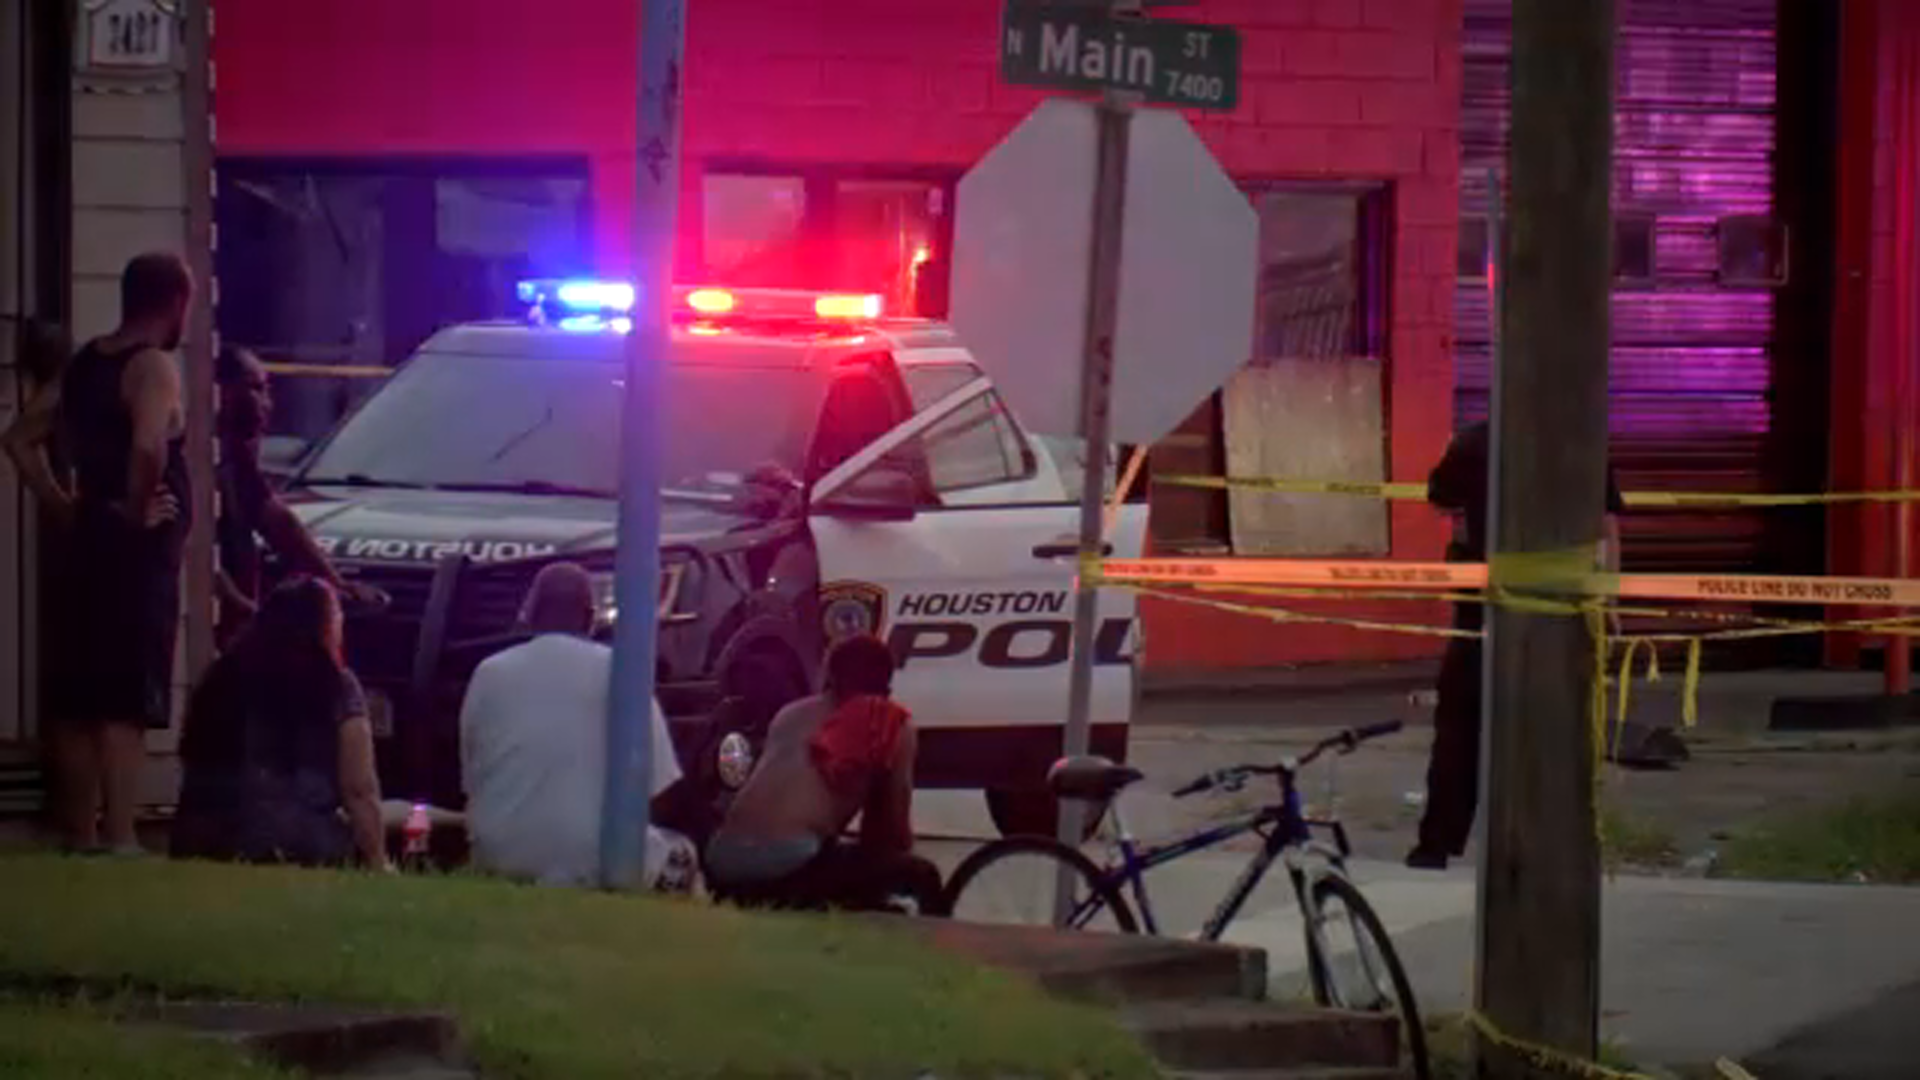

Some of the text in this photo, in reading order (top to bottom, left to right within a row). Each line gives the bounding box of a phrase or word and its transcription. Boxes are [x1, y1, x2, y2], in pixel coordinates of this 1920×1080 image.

[1006, 22, 1211, 86] N Main ST
[1161, 70, 1223, 101] 7400
[1697, 579, 1748, 595] POLICE
[1751, 580, 1783, 596] LINE
[1786, 582, 1808, 597] DO
[1811, 582, 1842, 598] NOT
[896, 591, 1067, 616] HOUSTON
